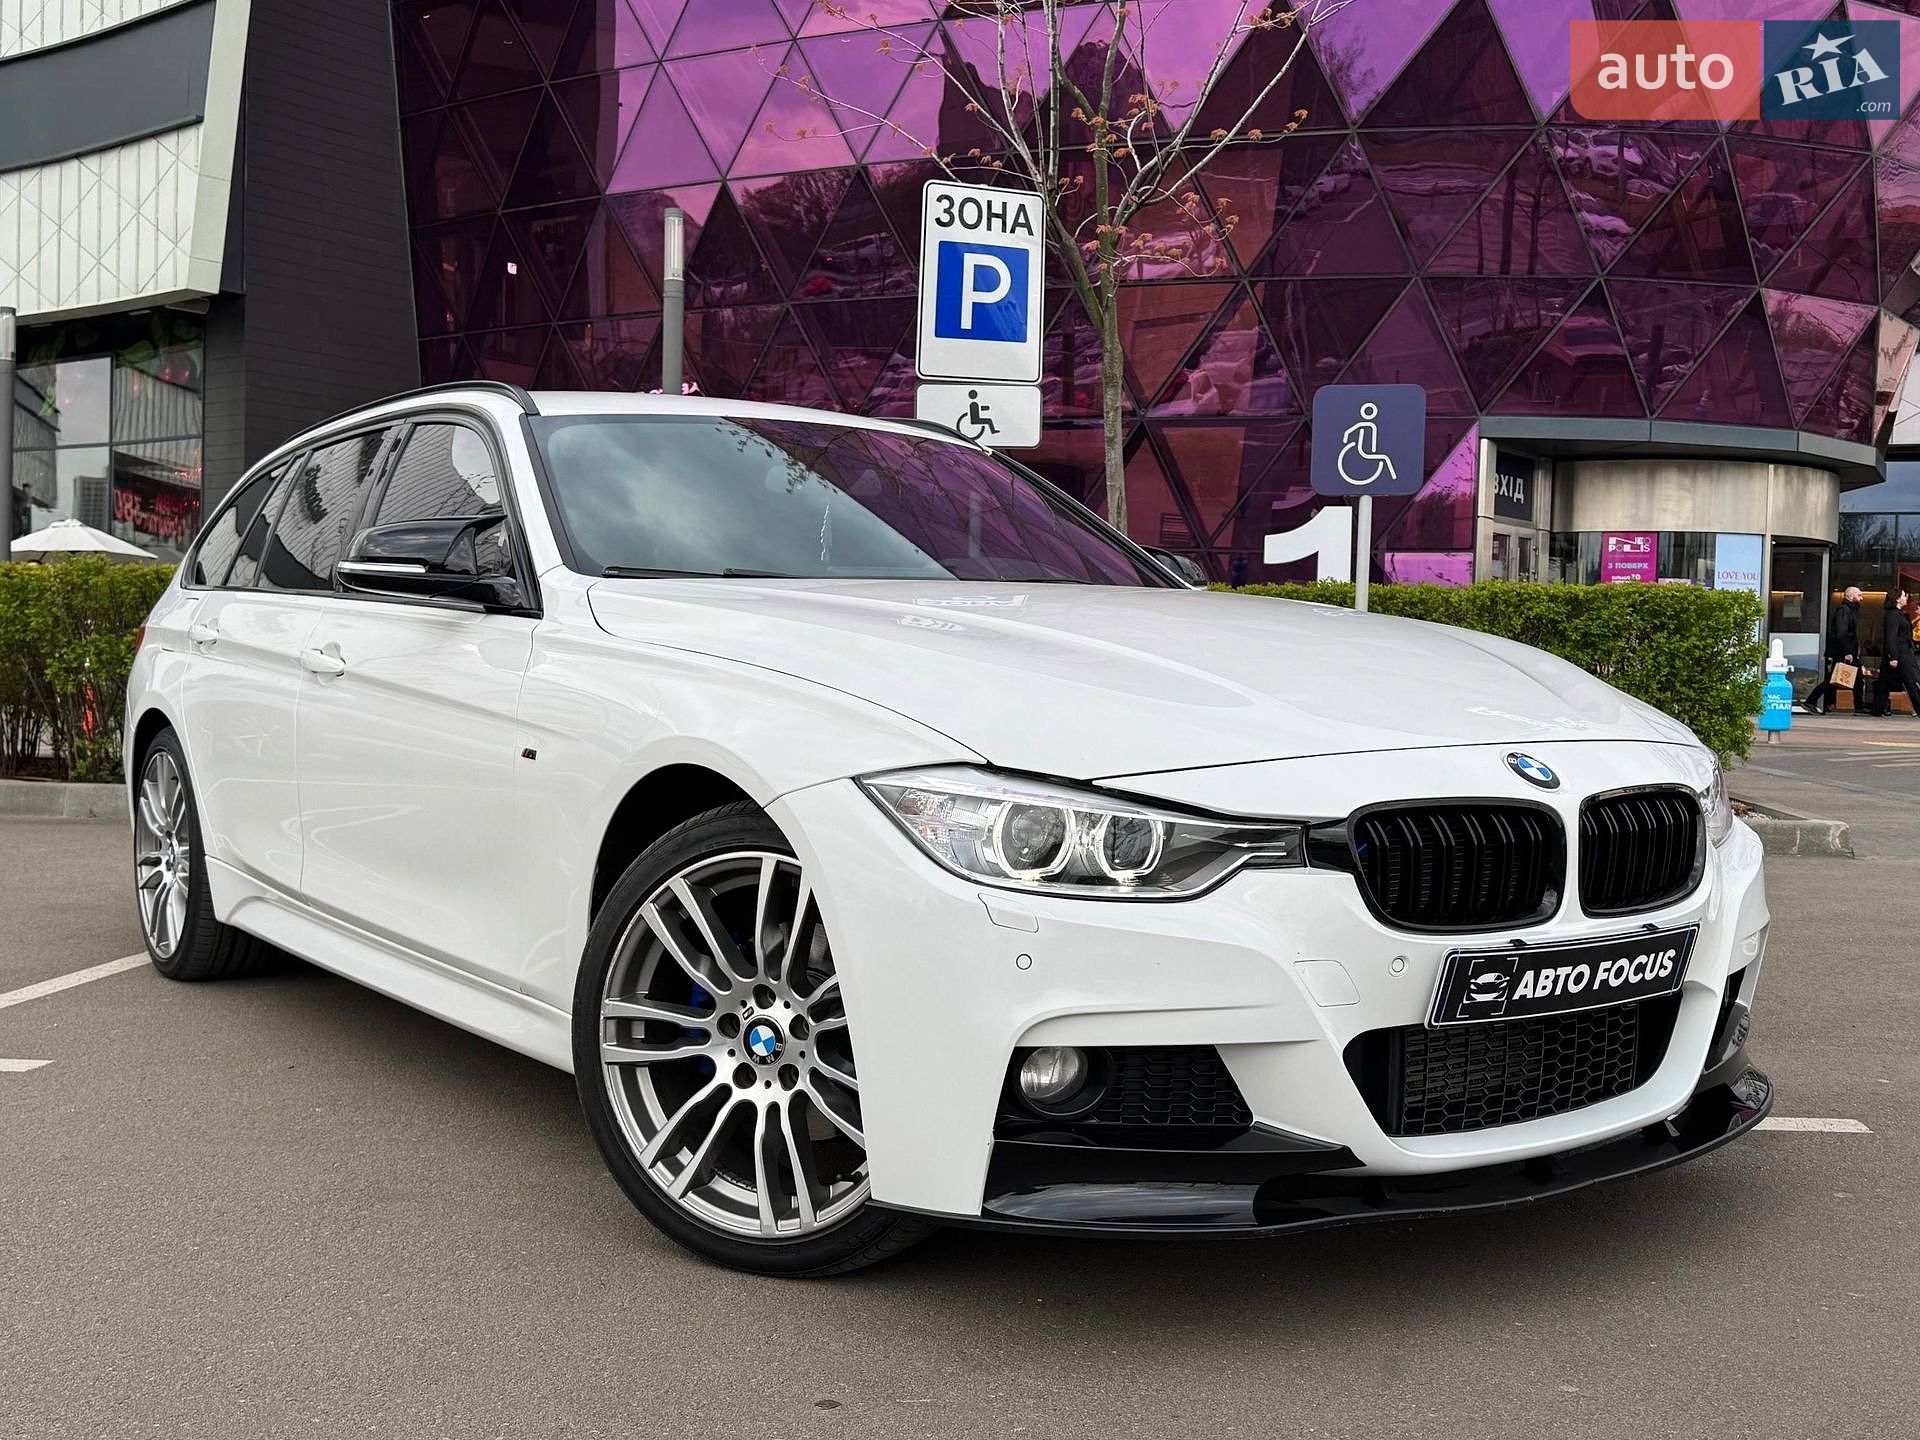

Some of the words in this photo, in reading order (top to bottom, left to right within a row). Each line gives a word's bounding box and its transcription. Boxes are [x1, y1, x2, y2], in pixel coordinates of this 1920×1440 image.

[934, 193, 1035, 237] ЗОНА
[960, 252, 1012, 331] P
[1263, 505, 1353, 587] 1
[1717, 570, 1740, 580] LOVE
[1743, 571, 1759, 580] YOU
[1512, 963, 1591, 1000] АВТО
[1592, 949, 1676, 991] FOCUS
